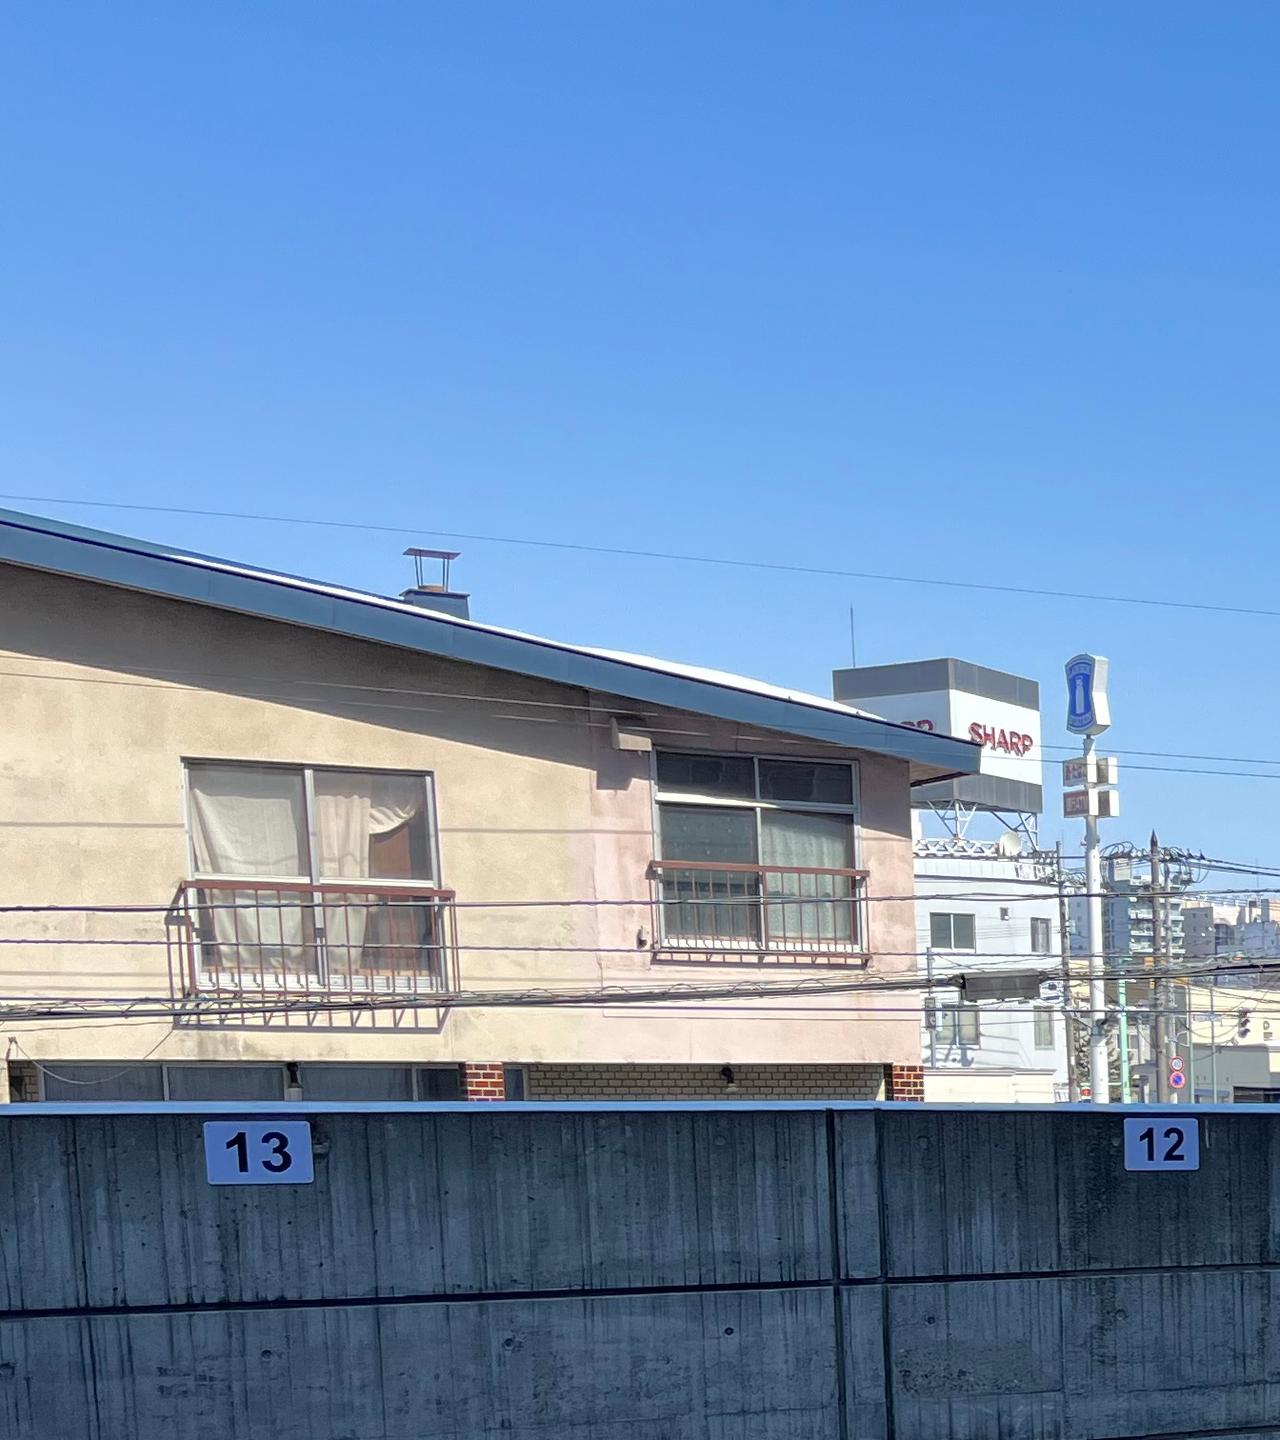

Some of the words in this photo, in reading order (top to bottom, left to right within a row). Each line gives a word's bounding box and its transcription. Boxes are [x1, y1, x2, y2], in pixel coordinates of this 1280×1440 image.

[968, 722, 1034, 757] SHARP
[225, 1131, 292, 1173] 13
[1139, 1127, 1185, 1162] 12
